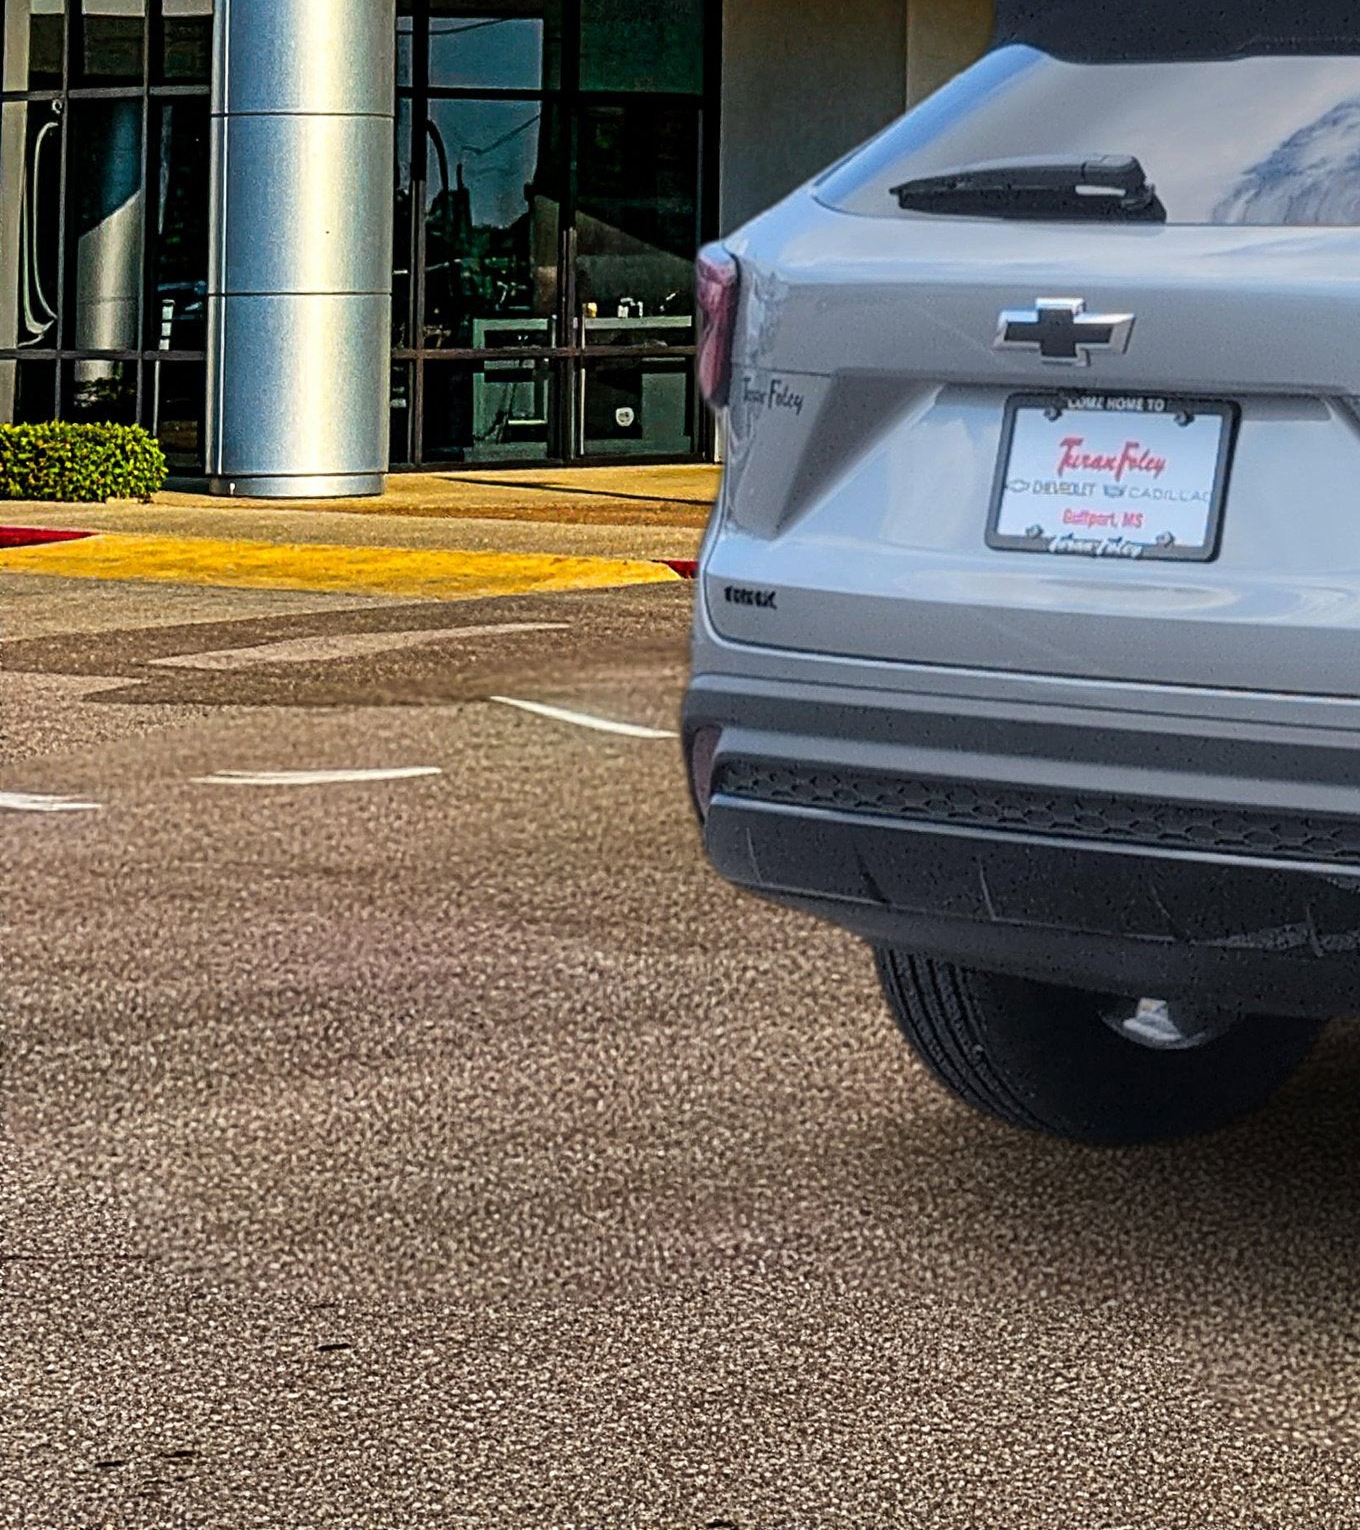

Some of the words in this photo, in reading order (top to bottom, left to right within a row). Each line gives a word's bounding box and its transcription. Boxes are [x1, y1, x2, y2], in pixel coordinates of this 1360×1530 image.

[1106, 397, 1144, 412] HOME
[1146, 398, 1165, 412] TO
[1121, 511, 1144, 528] MS
